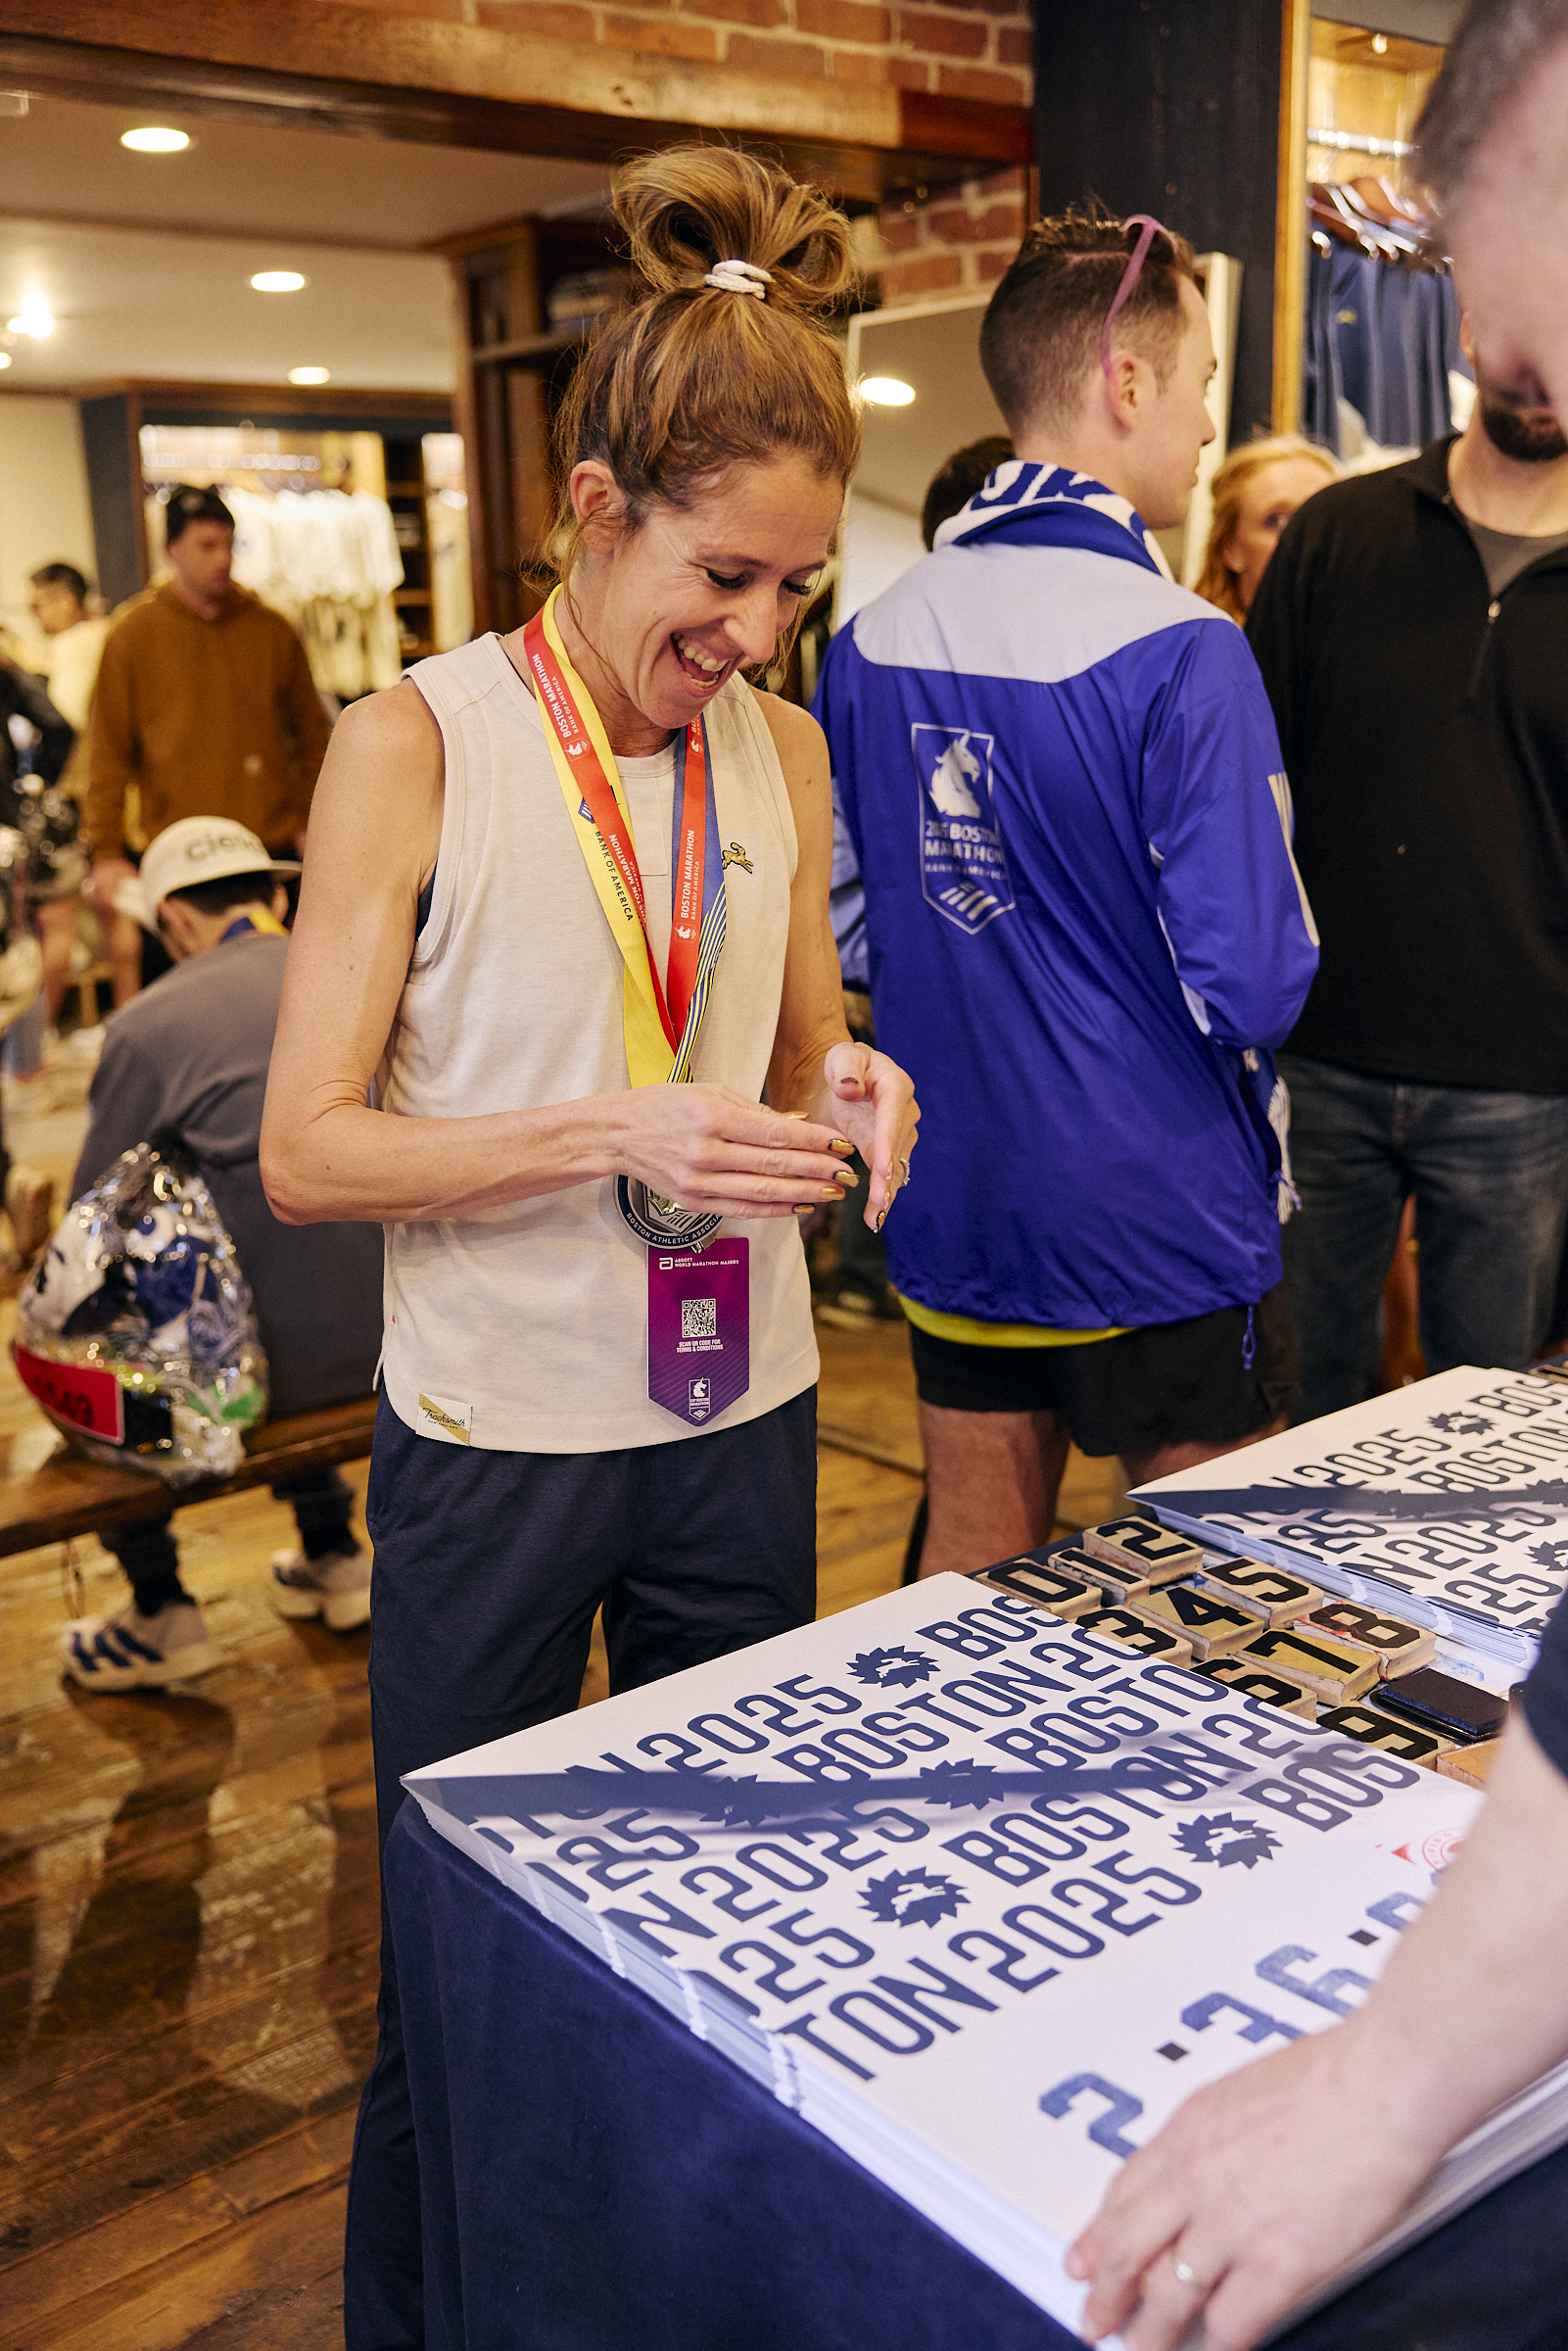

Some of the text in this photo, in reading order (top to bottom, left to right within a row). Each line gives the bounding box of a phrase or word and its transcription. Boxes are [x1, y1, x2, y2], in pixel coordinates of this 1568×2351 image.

[532, 652, 572, 739] BOSTON MARATHON
[551, 676, 568, 706] AMERICA
[567, 715, 579, 734] BANK
[608, 834, 635, 885] MARATHON
[925, 840, 1004, 864] MAATHO
[950, 823, 999, 845] BOS
[594, 831, 634, 922] BANK OF AMERICA
[680, 830, 695, 919] BOSTON MARATHON
[691, 892, 697, 901] OF
[627, 1213, 651, 1238] BOSTON
[651, 1234, 689, 1244] ATHLETIC
[422, 1407, 465, 1427] Tracksmith
[1294, 1428, 1452, 1488] 2025
[1096, 1520, 1193, 1561] 2
[1261, 1510, 1387, 1561] 25
[1078, 1559, 1310, 1655] 3 4 5
[1242, 1630, 1360, 1674] 7
[1309, 1603, 1421, 1649] 8
[636, 1674, 863, 1774] 2025
[771, 1659, 1077, 1787] BOSTON
[939, 1732, 1259, 1888] BOSTON
[775, 1741, 1420, 2082] TON 2025 BOS
